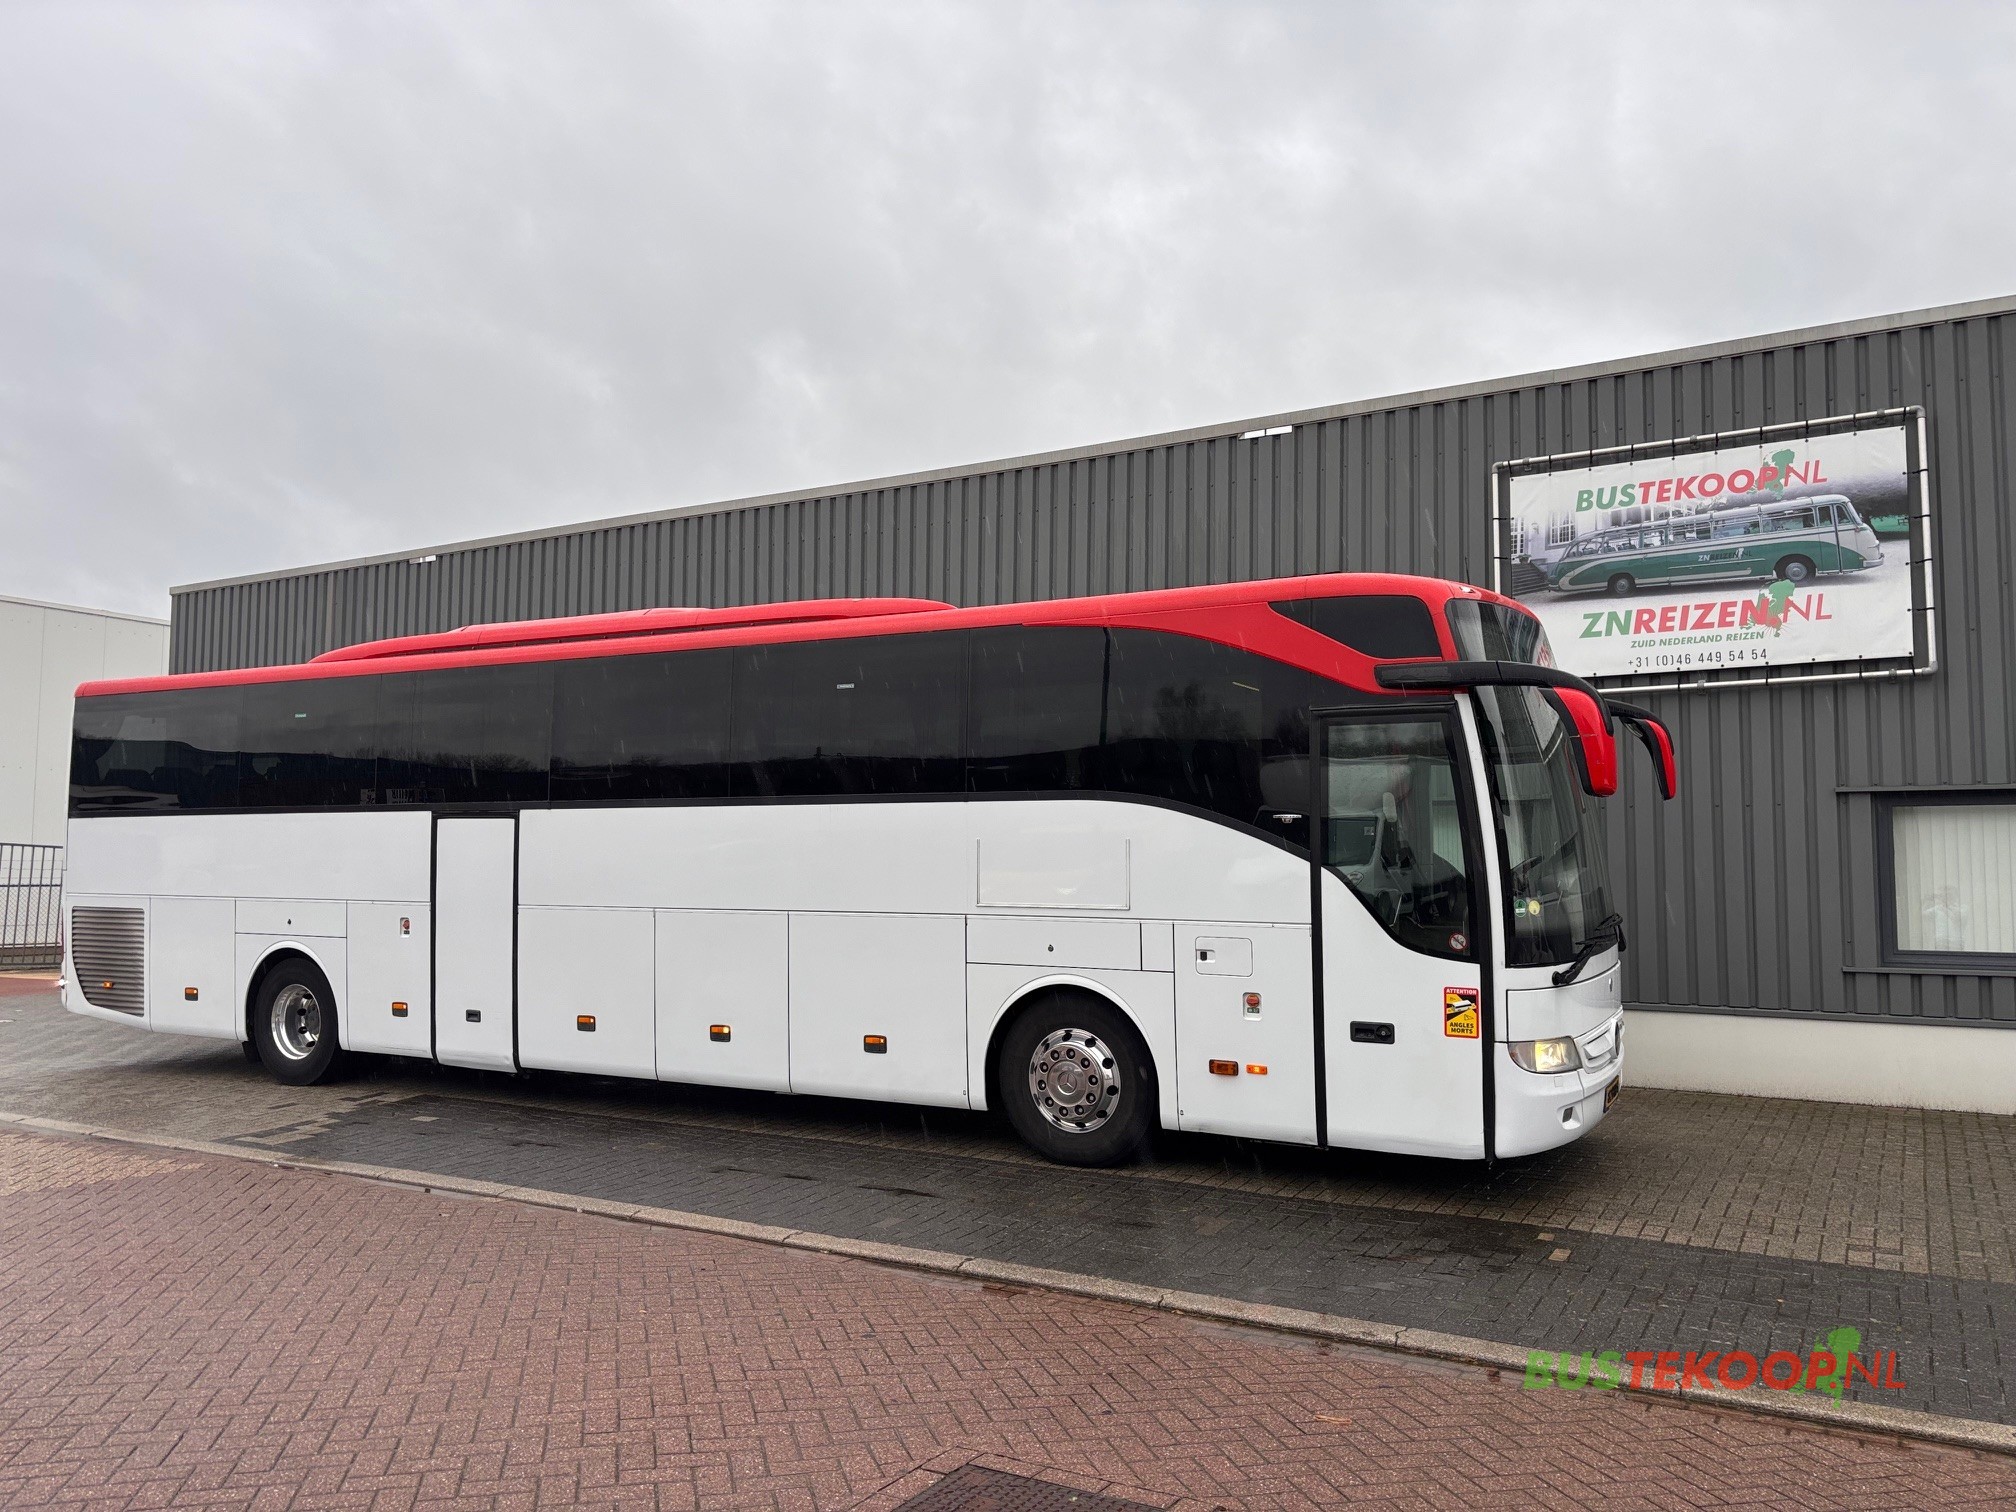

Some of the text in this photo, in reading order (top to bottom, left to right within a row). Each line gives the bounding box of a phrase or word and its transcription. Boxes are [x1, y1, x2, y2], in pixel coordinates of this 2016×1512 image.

[1576, 460, 1827, 512] BUSTEKOOP.NL
[1630, 631, 1764, 648] ZUID NEDERLAND REIZEN
[1628, 648, 1767, 667] +31 (0)46 449 54 54
